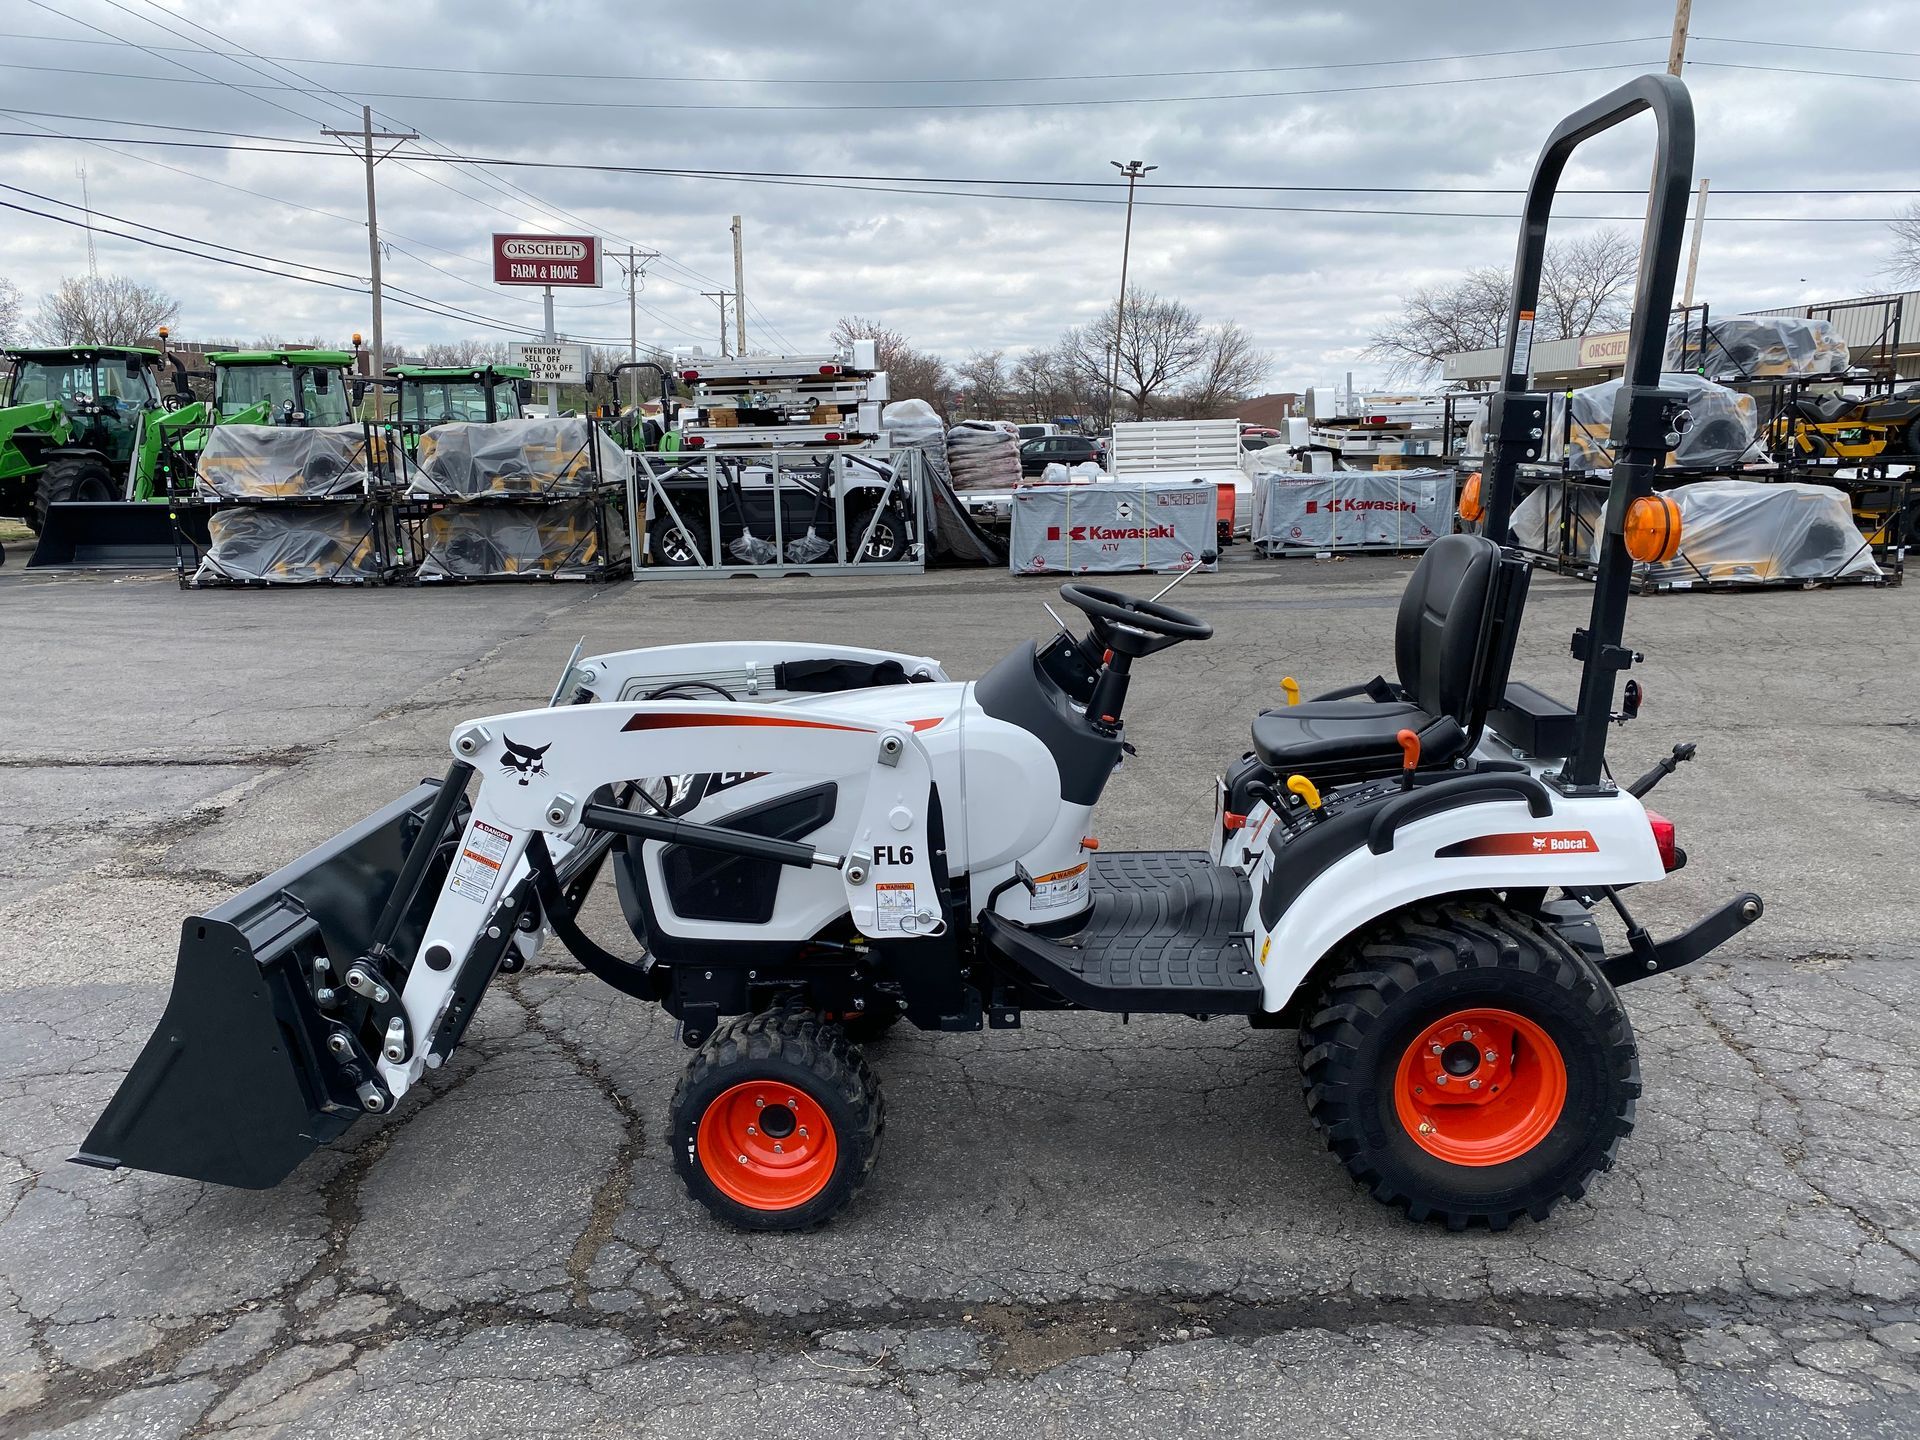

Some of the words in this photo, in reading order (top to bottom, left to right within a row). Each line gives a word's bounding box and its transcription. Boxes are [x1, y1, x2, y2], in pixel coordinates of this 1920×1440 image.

[507, 243, 580, 258] ORSCHELN
[510, 263, 538, 279] FARM
[540, 266, 547, 279] &
[550, 265, 578, 280] HOME
[521, 346, 561, 355] INVENTORY
[1589, 341, 1627, 358] ORSCHEL
[524, 355, 541, 363] SELL
[560, 364, 573, 372] OFF
[1090, 525, 1175, 540] Kawasaki
[1101, 543, 1120, 551] ATV
[484, 826, 510, 841] DANGER
[1550, 838, 1588, 850] Bobcat
[873, 845, 914, 865] FL6
